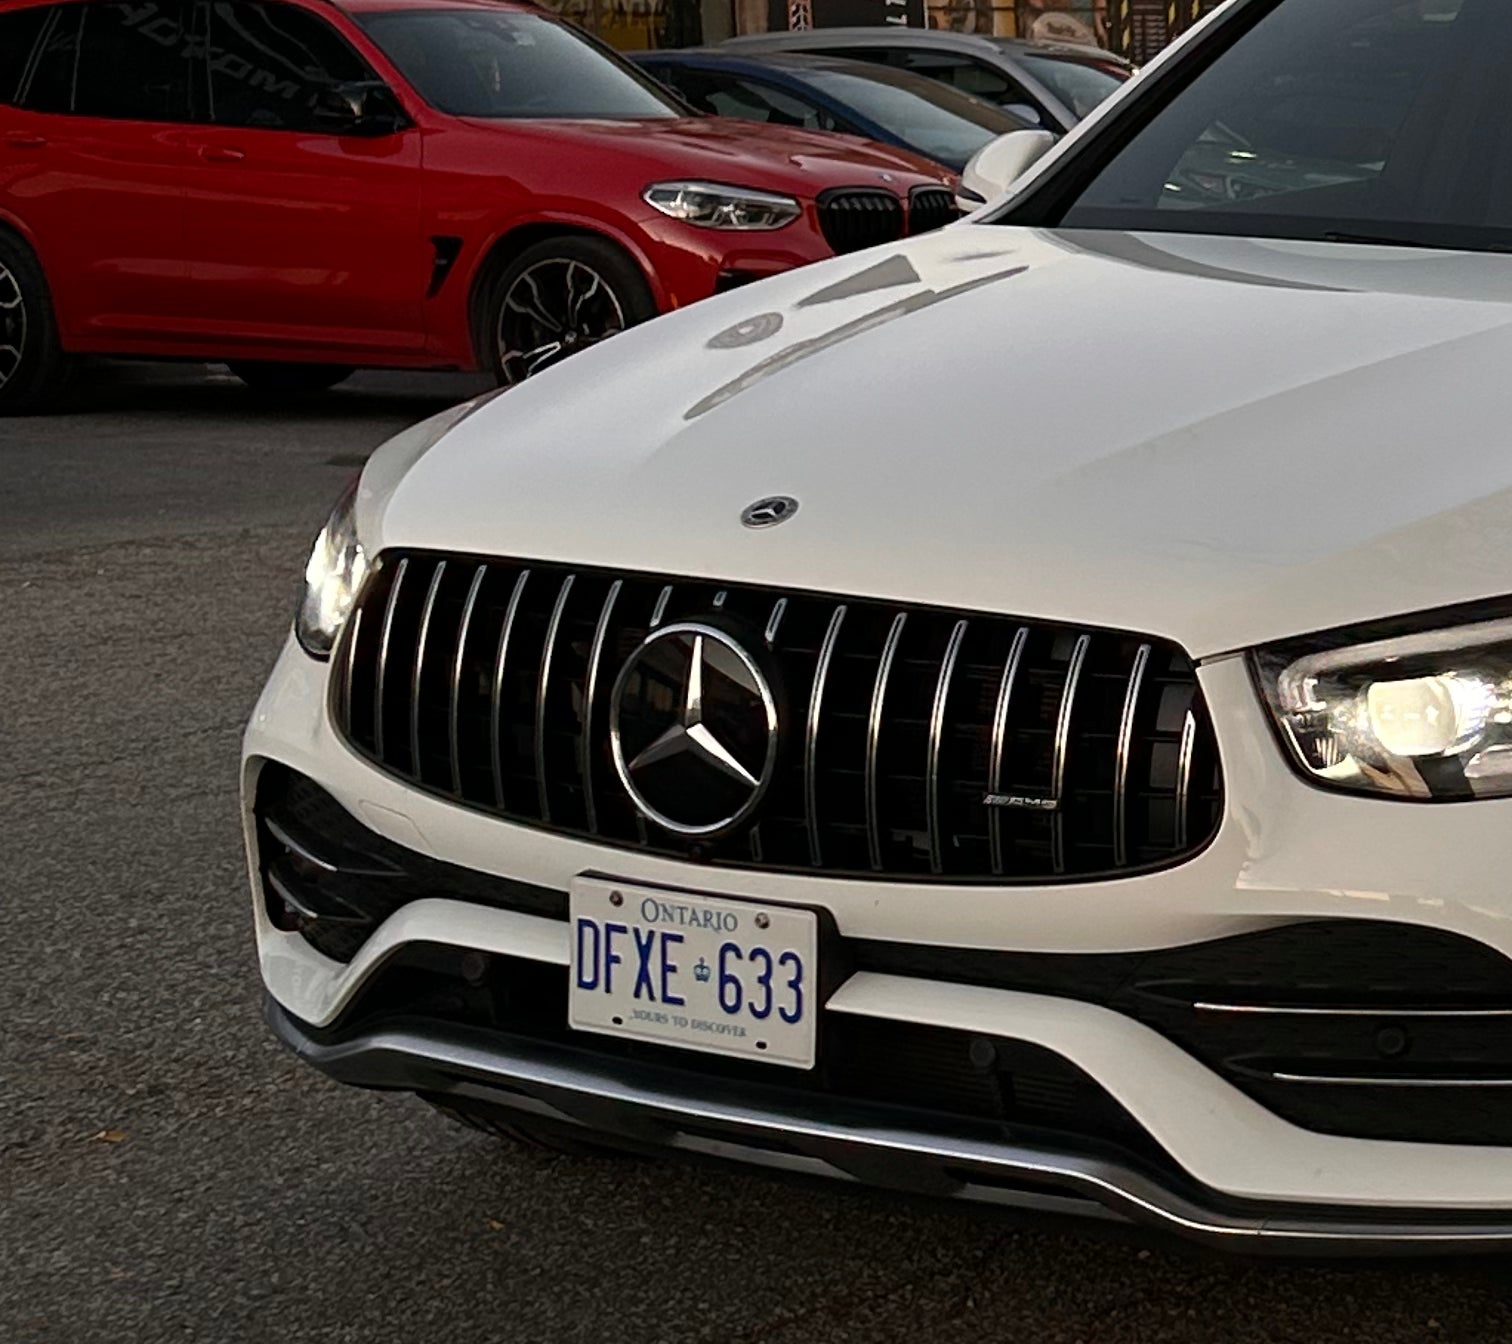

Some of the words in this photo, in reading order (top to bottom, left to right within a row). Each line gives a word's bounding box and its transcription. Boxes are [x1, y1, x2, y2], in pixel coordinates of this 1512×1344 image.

[641, 898, 738, 932] ONTARIO
[577, 918, 686, 1007] DFXE
[718, 942, 803, 1024] 633
[632, 1009, 669, 1025] YOURS
[672, 1015, 688, 1027] TO
[691, 1018, 746, 1038] DISCOVER
